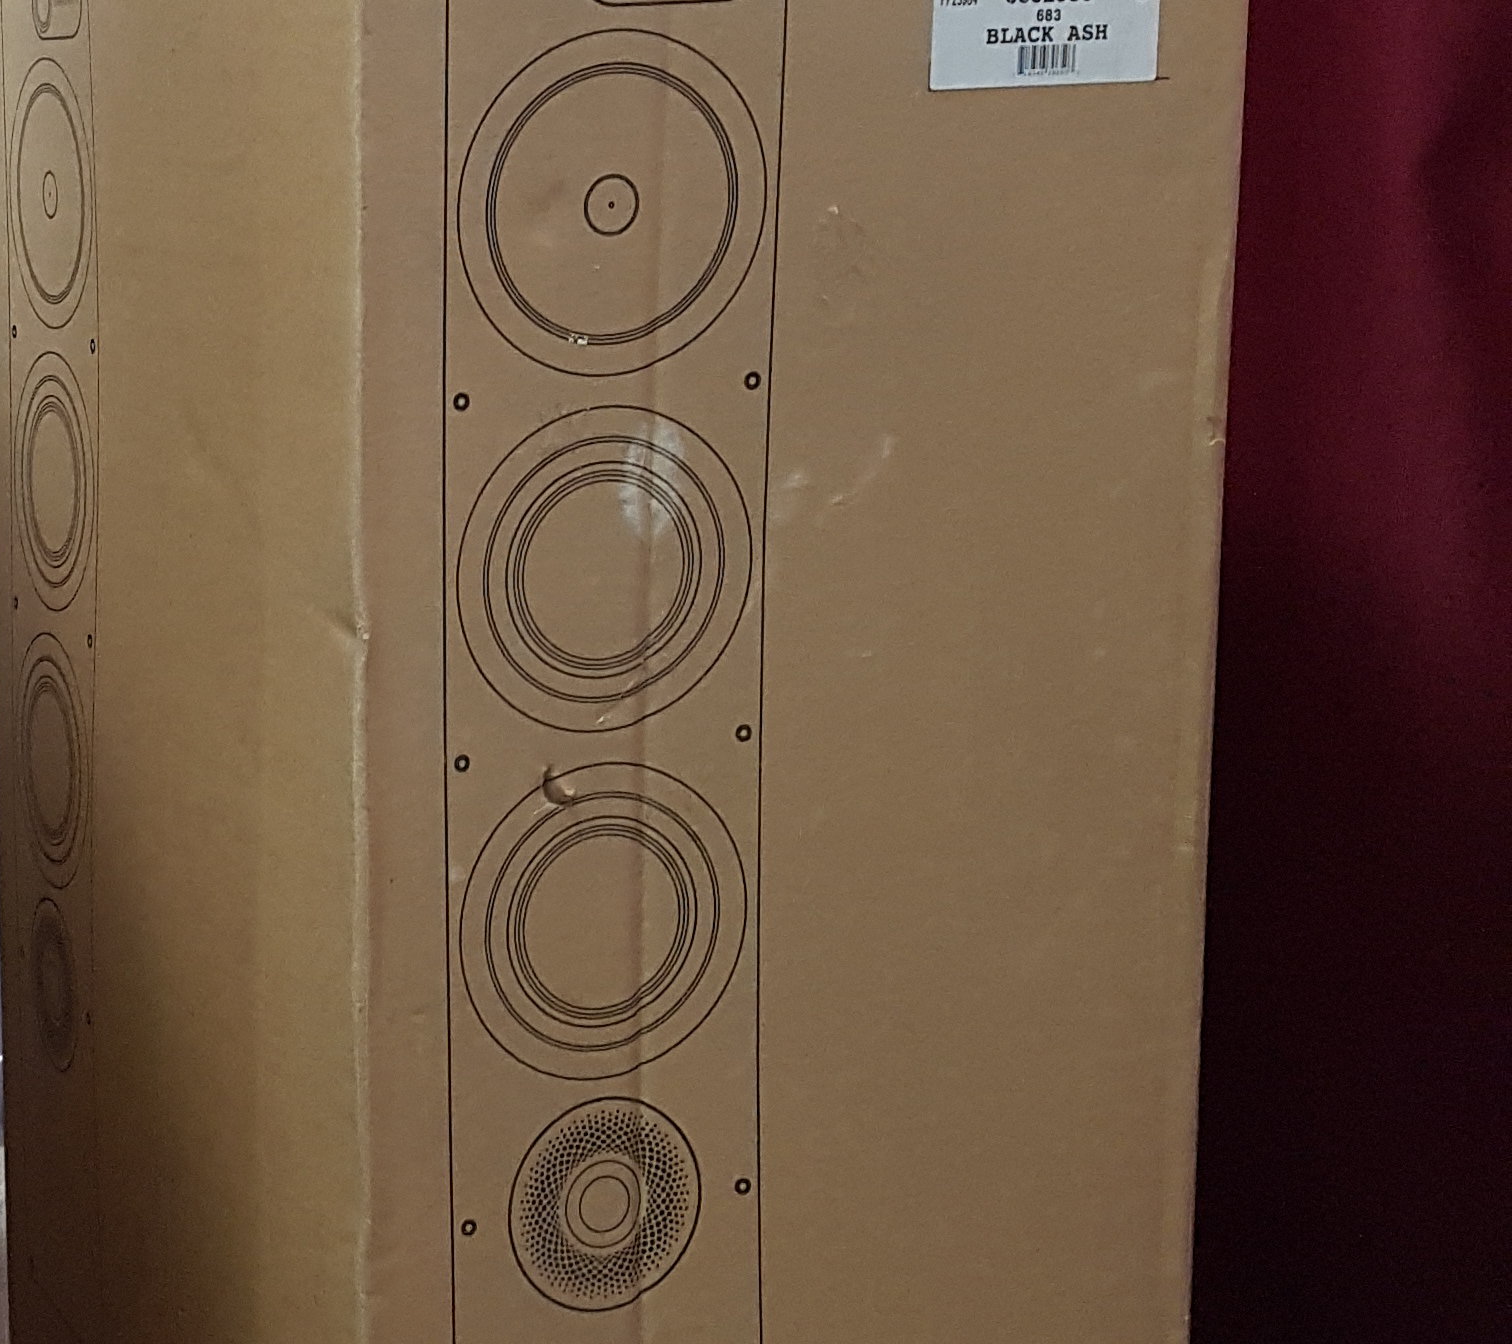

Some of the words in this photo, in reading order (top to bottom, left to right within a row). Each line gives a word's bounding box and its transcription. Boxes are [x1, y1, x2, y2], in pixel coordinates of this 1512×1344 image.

[1036, 9, 1061, 22] 683
[986, 26, 1054, 44] BLACK
[1067, 24, 1108, 42] ASH
